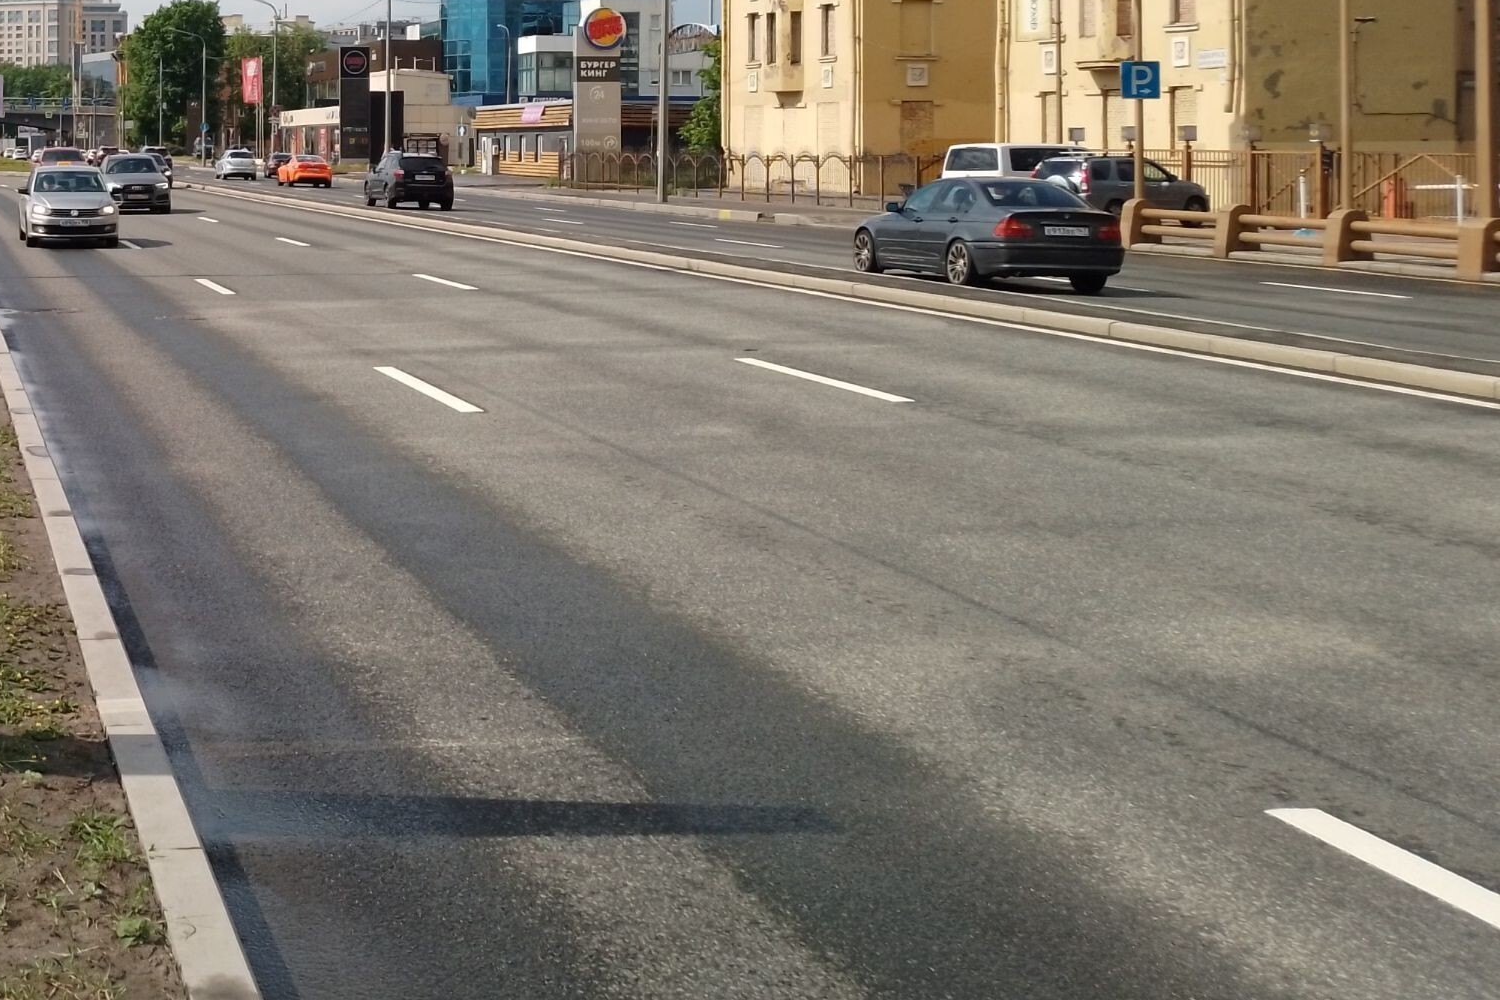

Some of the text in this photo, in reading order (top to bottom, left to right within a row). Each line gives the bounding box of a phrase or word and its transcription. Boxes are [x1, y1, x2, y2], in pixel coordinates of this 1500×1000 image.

[580, 61, 617, 69] БУРГЕР
[580, 69, 608, 78] КИНГ
[1131, 65, 1153, 95] P
